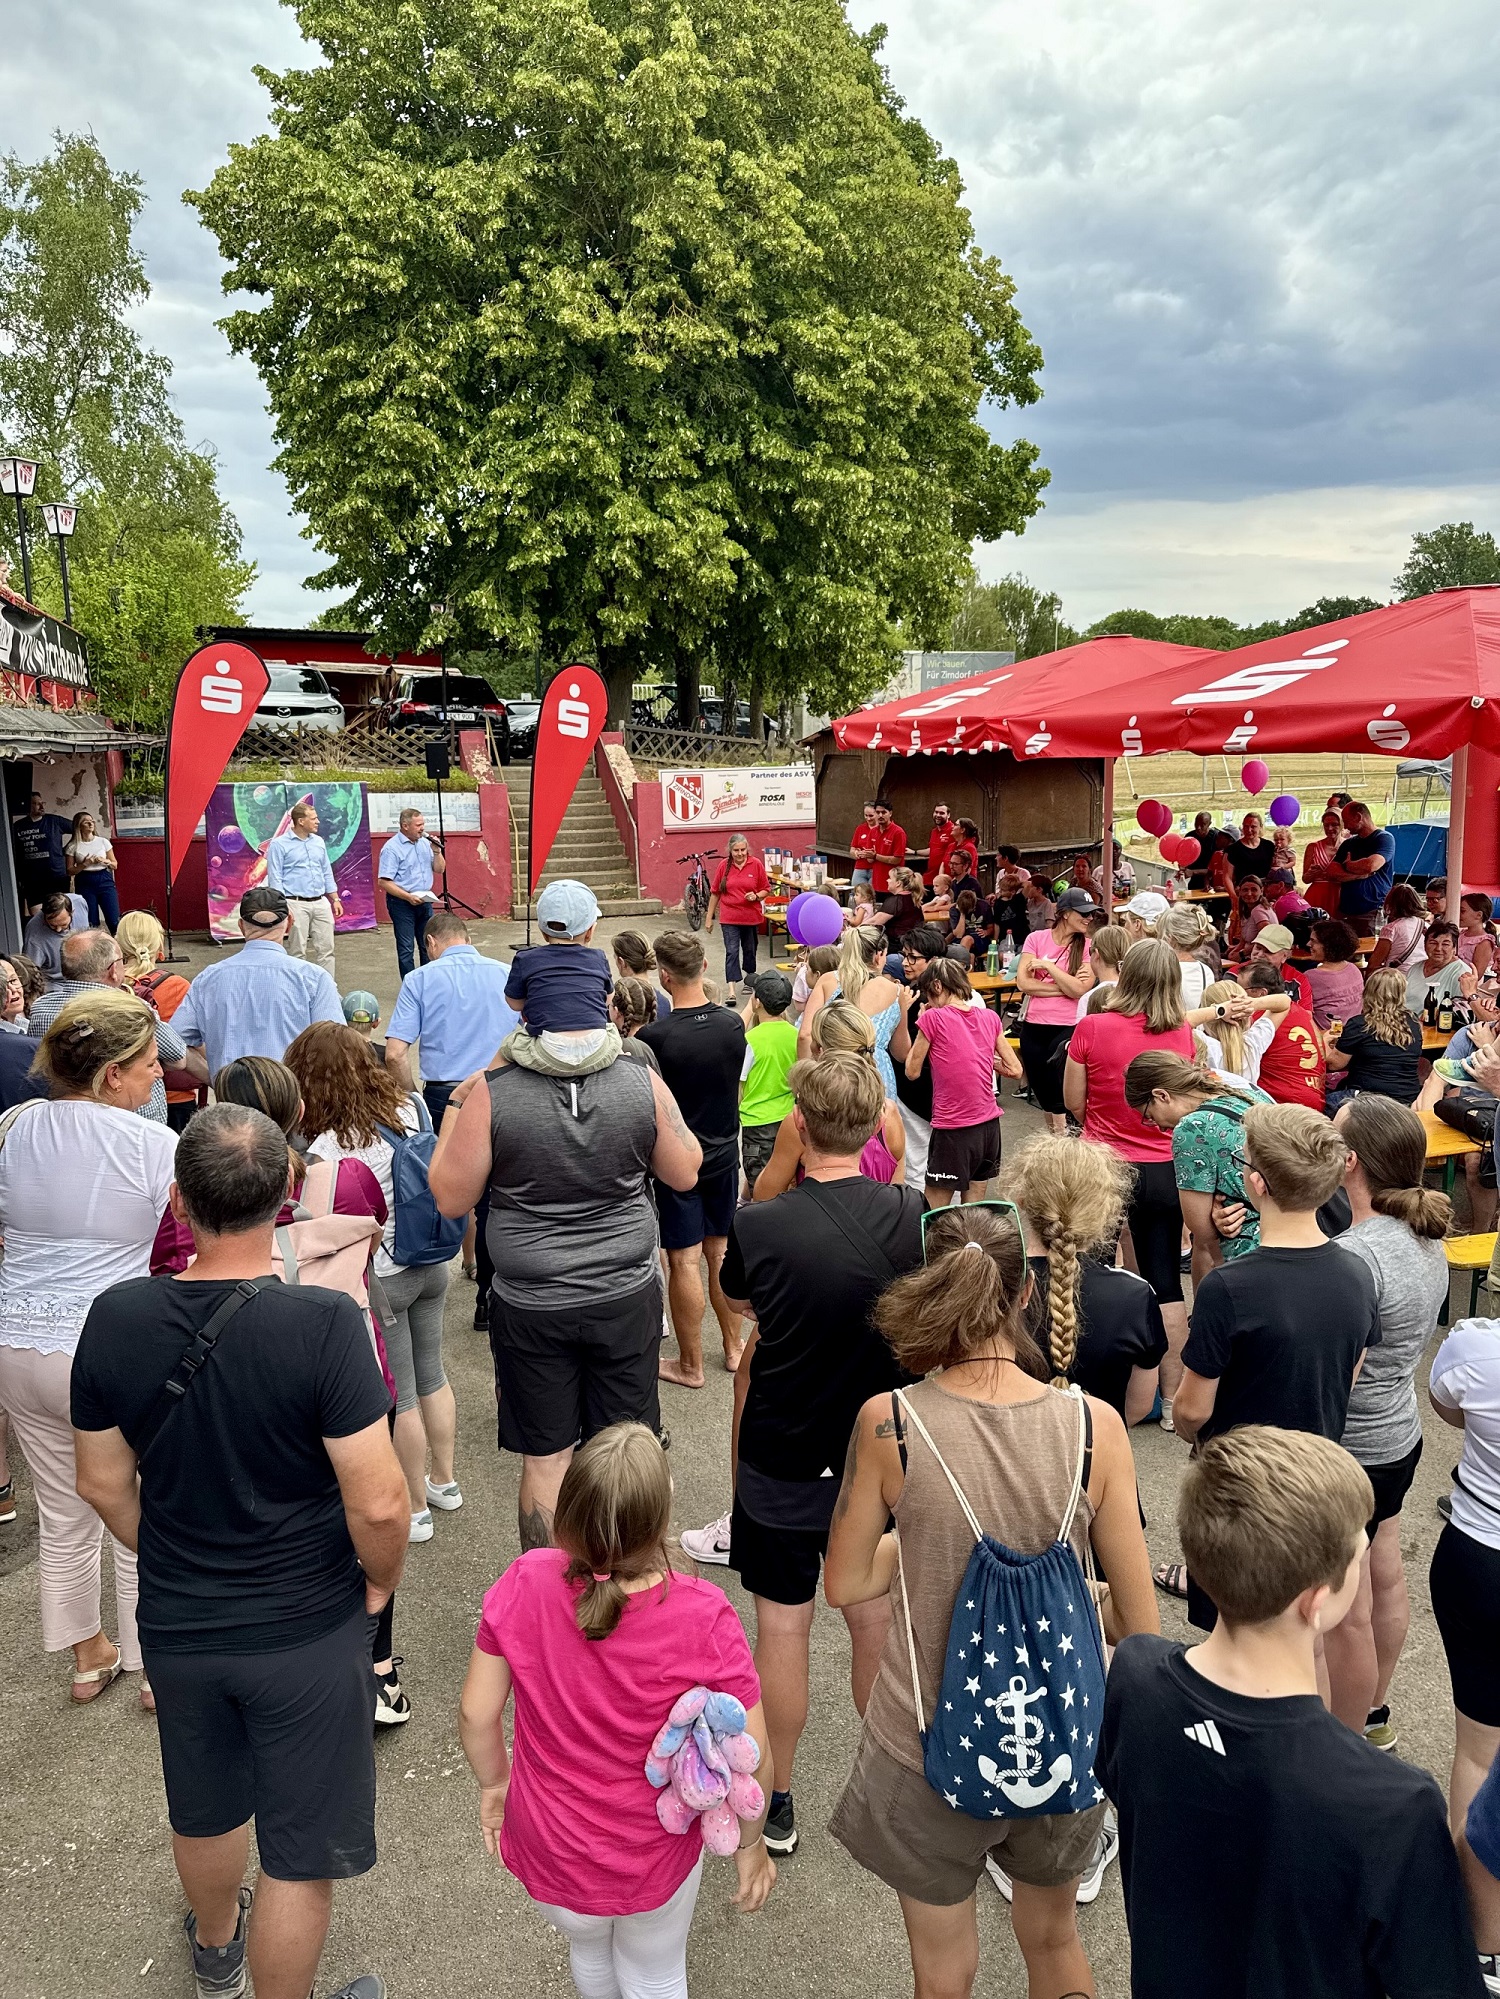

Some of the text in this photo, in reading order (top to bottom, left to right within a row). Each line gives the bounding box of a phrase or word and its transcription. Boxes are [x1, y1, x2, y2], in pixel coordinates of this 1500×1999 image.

[927, 660, 940, 668] Wir
[926, 670, 939, 679] Für
[683, 777, 701, 796] ASV
[672, 782, 702, 806] ZIRNDORF
[760, 794, 785, 802] ROSA
[1288, 1026, 1318, 1069] 3
